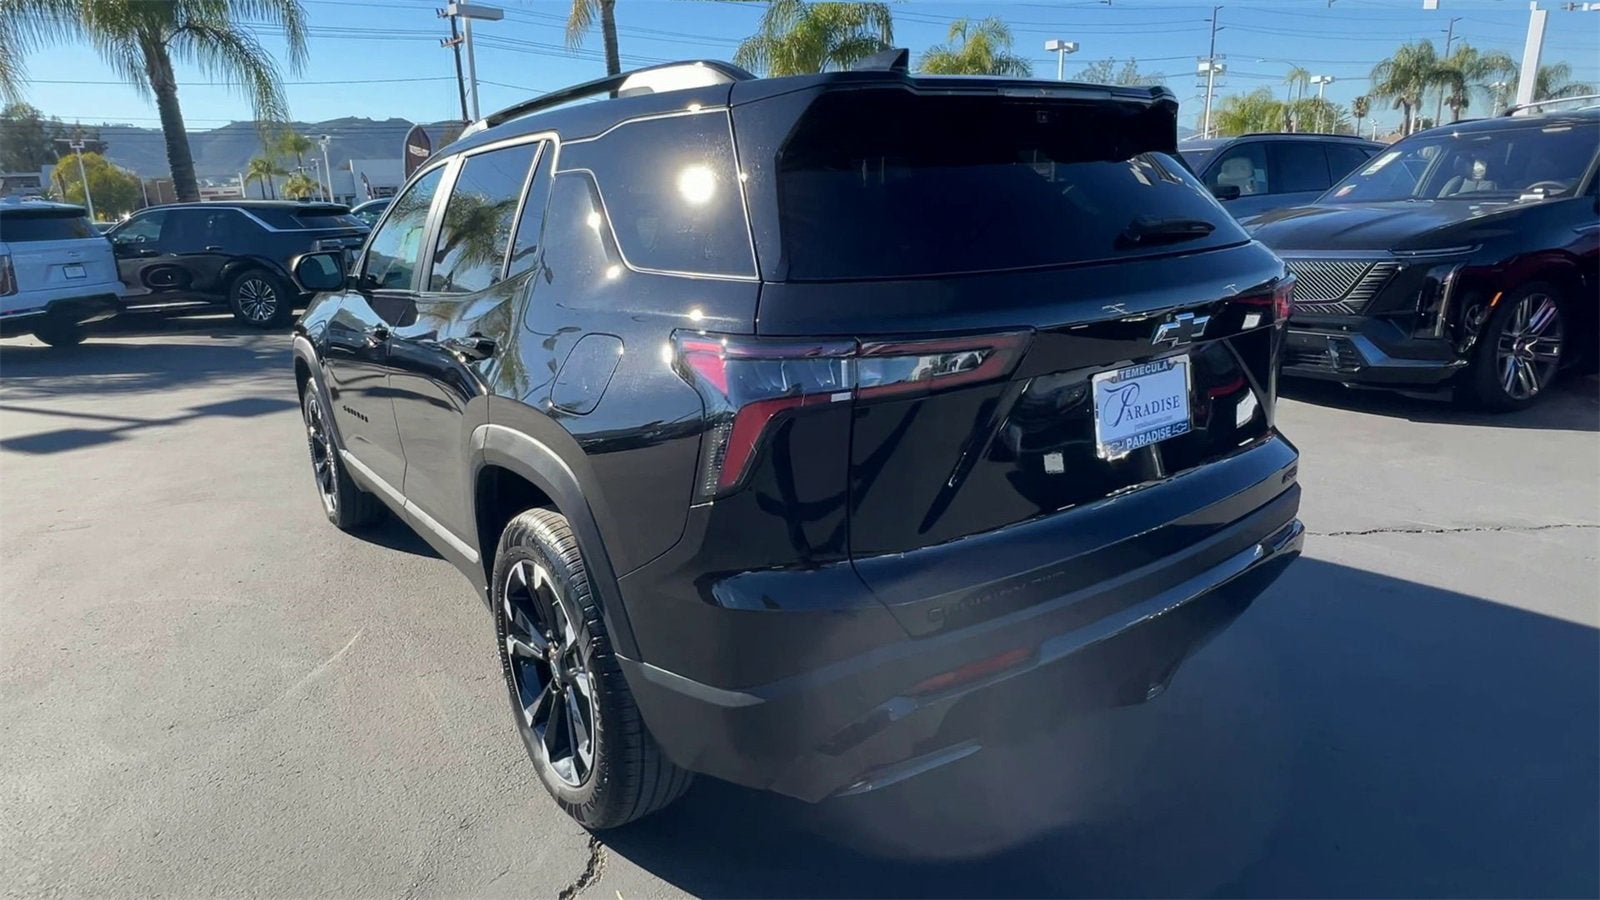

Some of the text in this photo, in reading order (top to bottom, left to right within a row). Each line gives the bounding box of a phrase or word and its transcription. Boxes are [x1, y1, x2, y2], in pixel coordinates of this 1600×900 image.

[1120, 361, 1168, 380] TEMECULA
[1103, 382, 1180, 428] PARADISE
[1126, 426, 1172, 450] PARADISE
